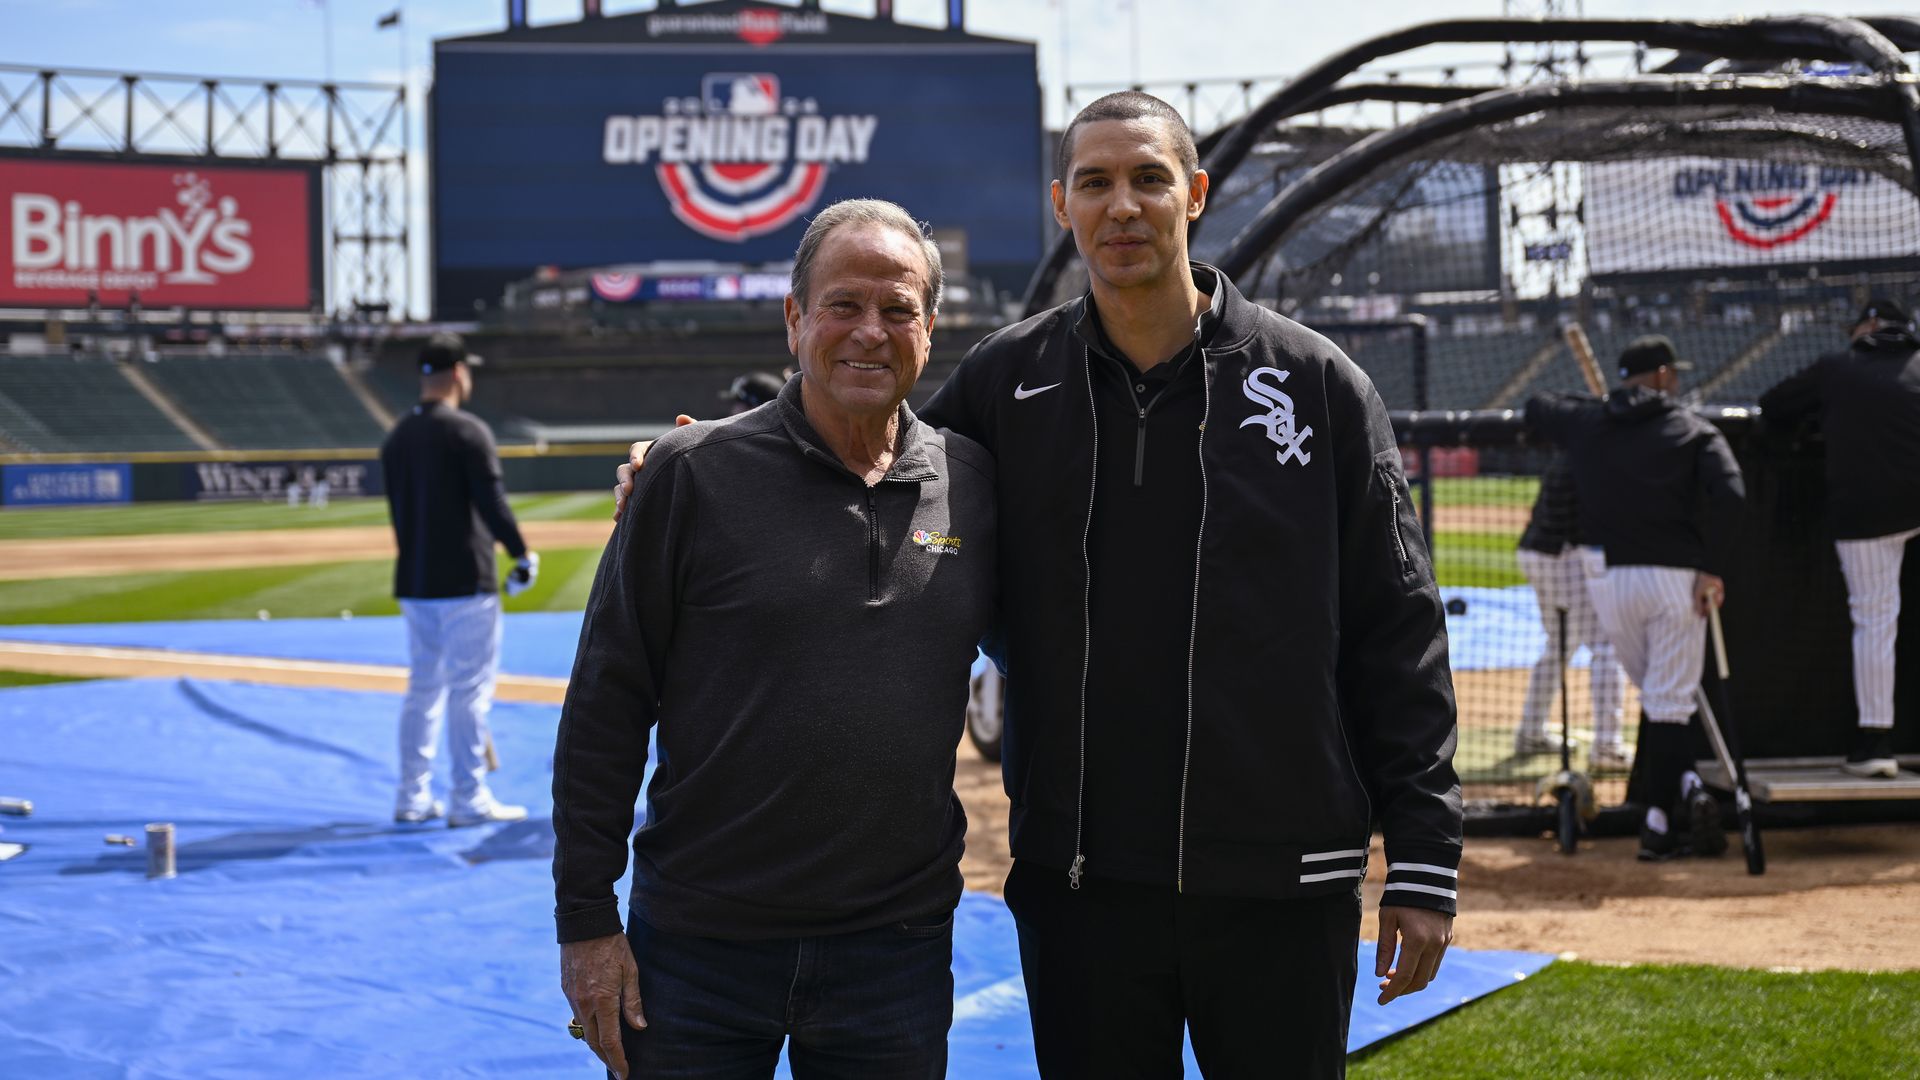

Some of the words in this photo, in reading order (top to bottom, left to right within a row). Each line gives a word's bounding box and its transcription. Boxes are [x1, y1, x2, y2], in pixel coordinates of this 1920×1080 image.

[603, 115, 789, 163] OPENING
[795, 115, 878, 163] DAY
[929, 531, 961, 548] Sports
[926, 544, 958, 555] CHICAGO
